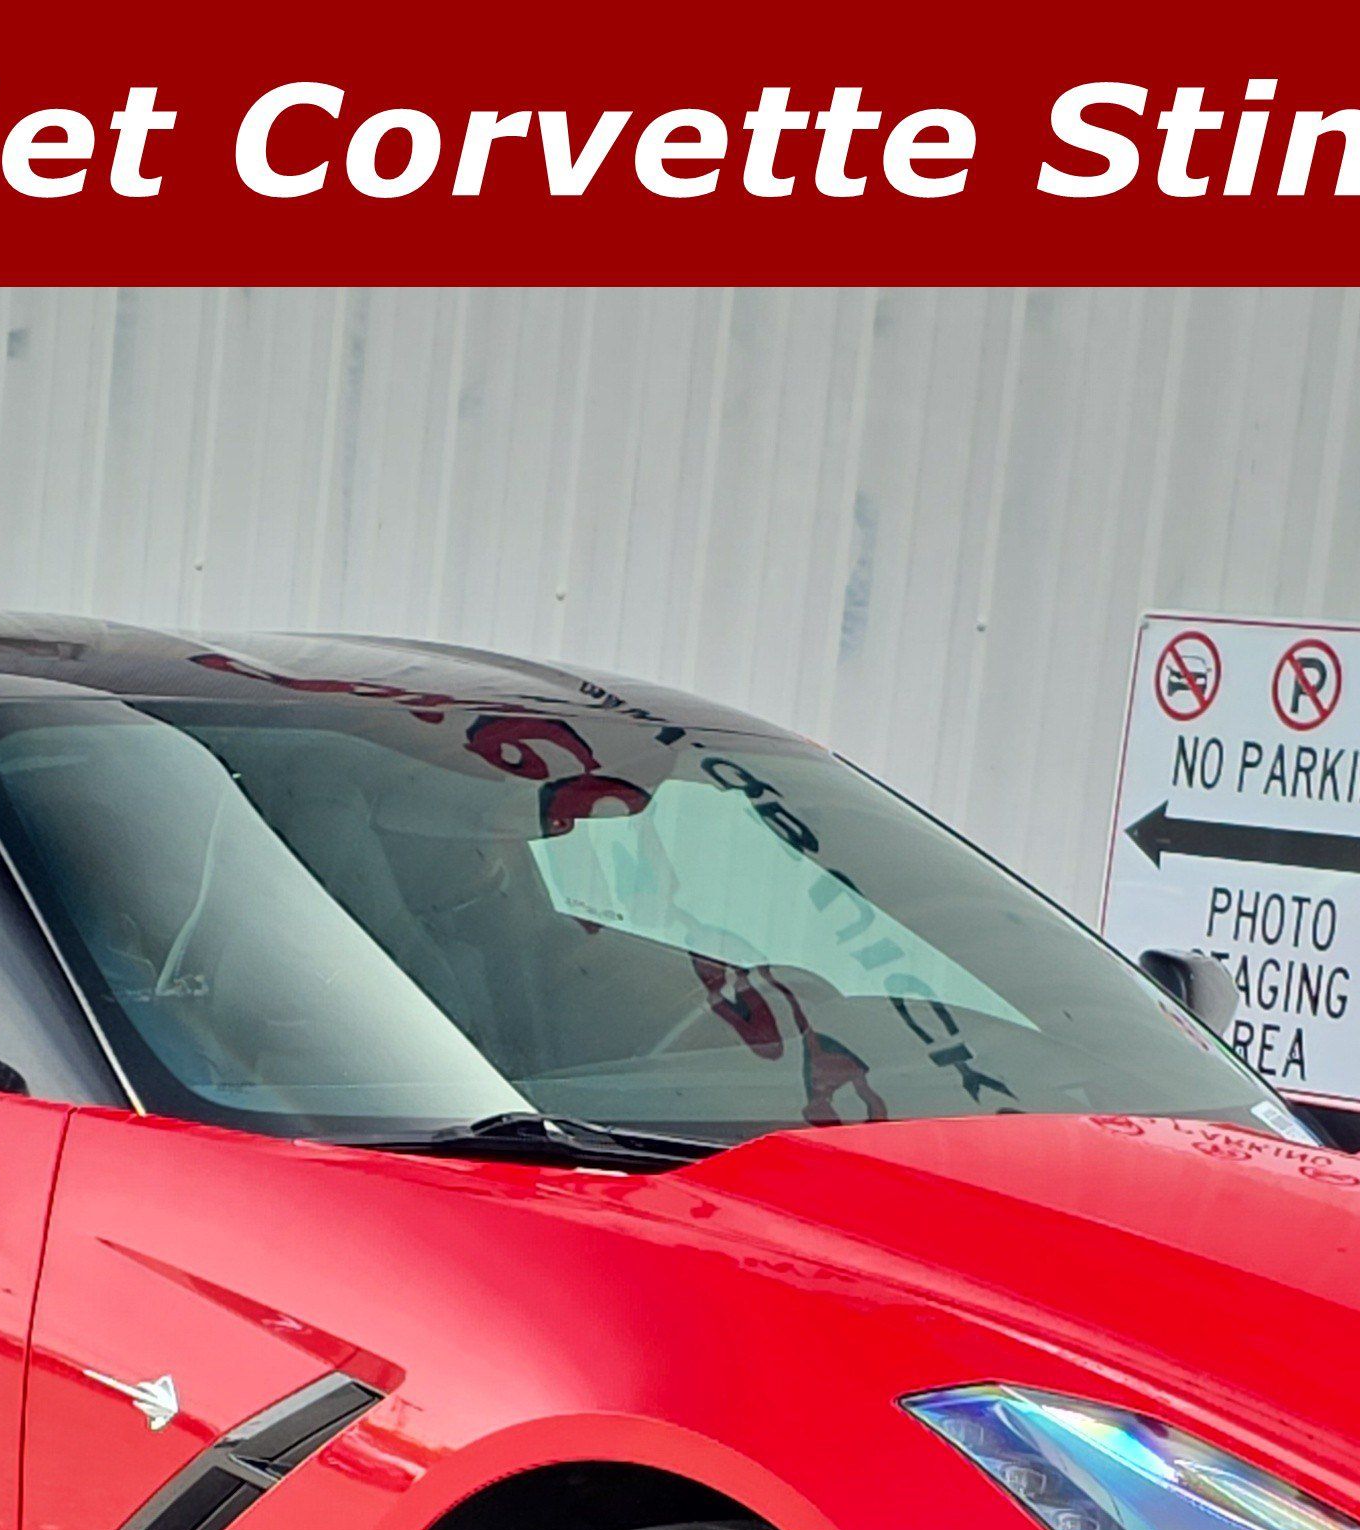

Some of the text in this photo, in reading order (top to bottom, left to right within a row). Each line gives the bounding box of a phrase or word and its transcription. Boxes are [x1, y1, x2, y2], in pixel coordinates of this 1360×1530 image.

[1171, 735, 1225, 791] NO
[1205, 886, 1338, 952] PHOTO
[1190, 948, 1351, 1020] AGING
[1230, 1019, 1308, 1083] REA
